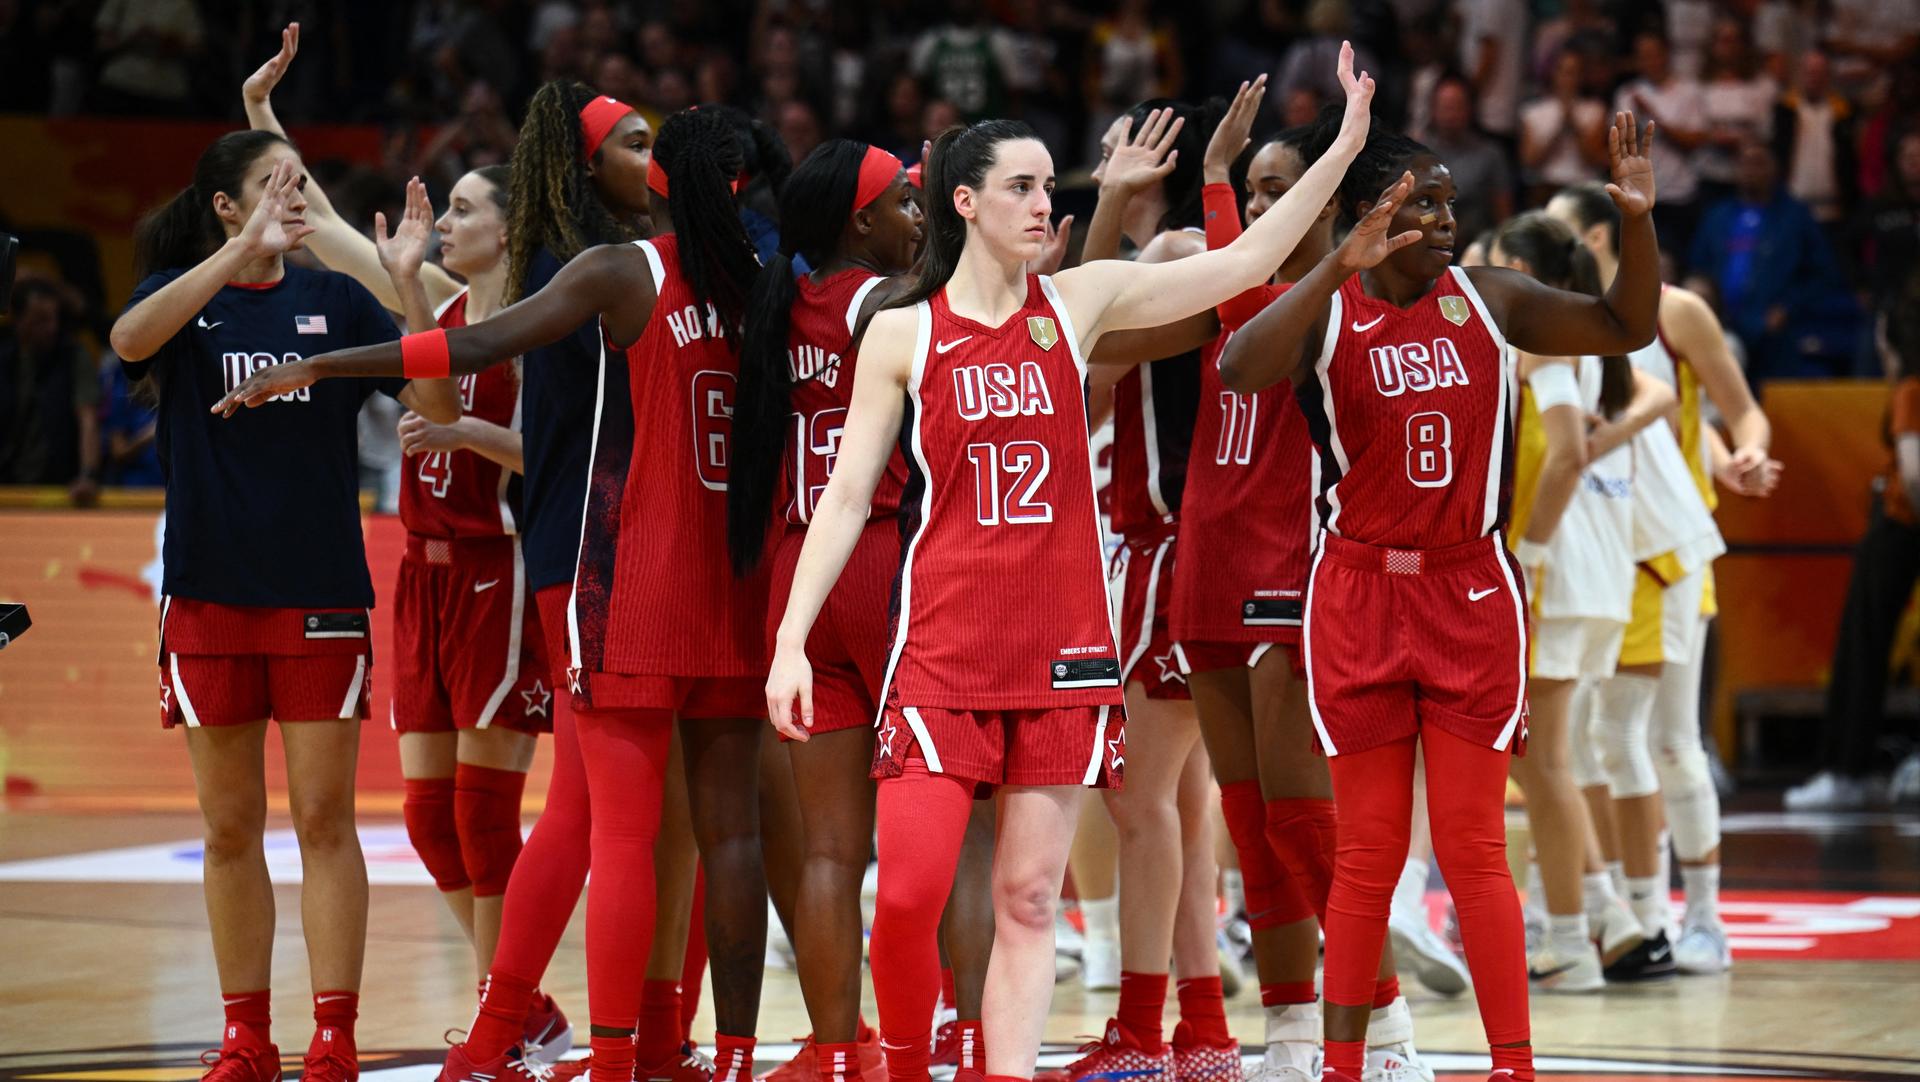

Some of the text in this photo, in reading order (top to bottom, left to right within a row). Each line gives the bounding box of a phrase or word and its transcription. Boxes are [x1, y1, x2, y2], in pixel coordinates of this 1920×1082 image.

[666, 303, 745, 348] HOW
[953, 361, 1054, 421] USA
[1369, 338, 1470, 397] USA
[1216, 391, 1257, 465] 11
[1406, 411, 1452, 488] 8
[419, 451, 452, 498] 4
[968, 440, 1053, 526] 12
